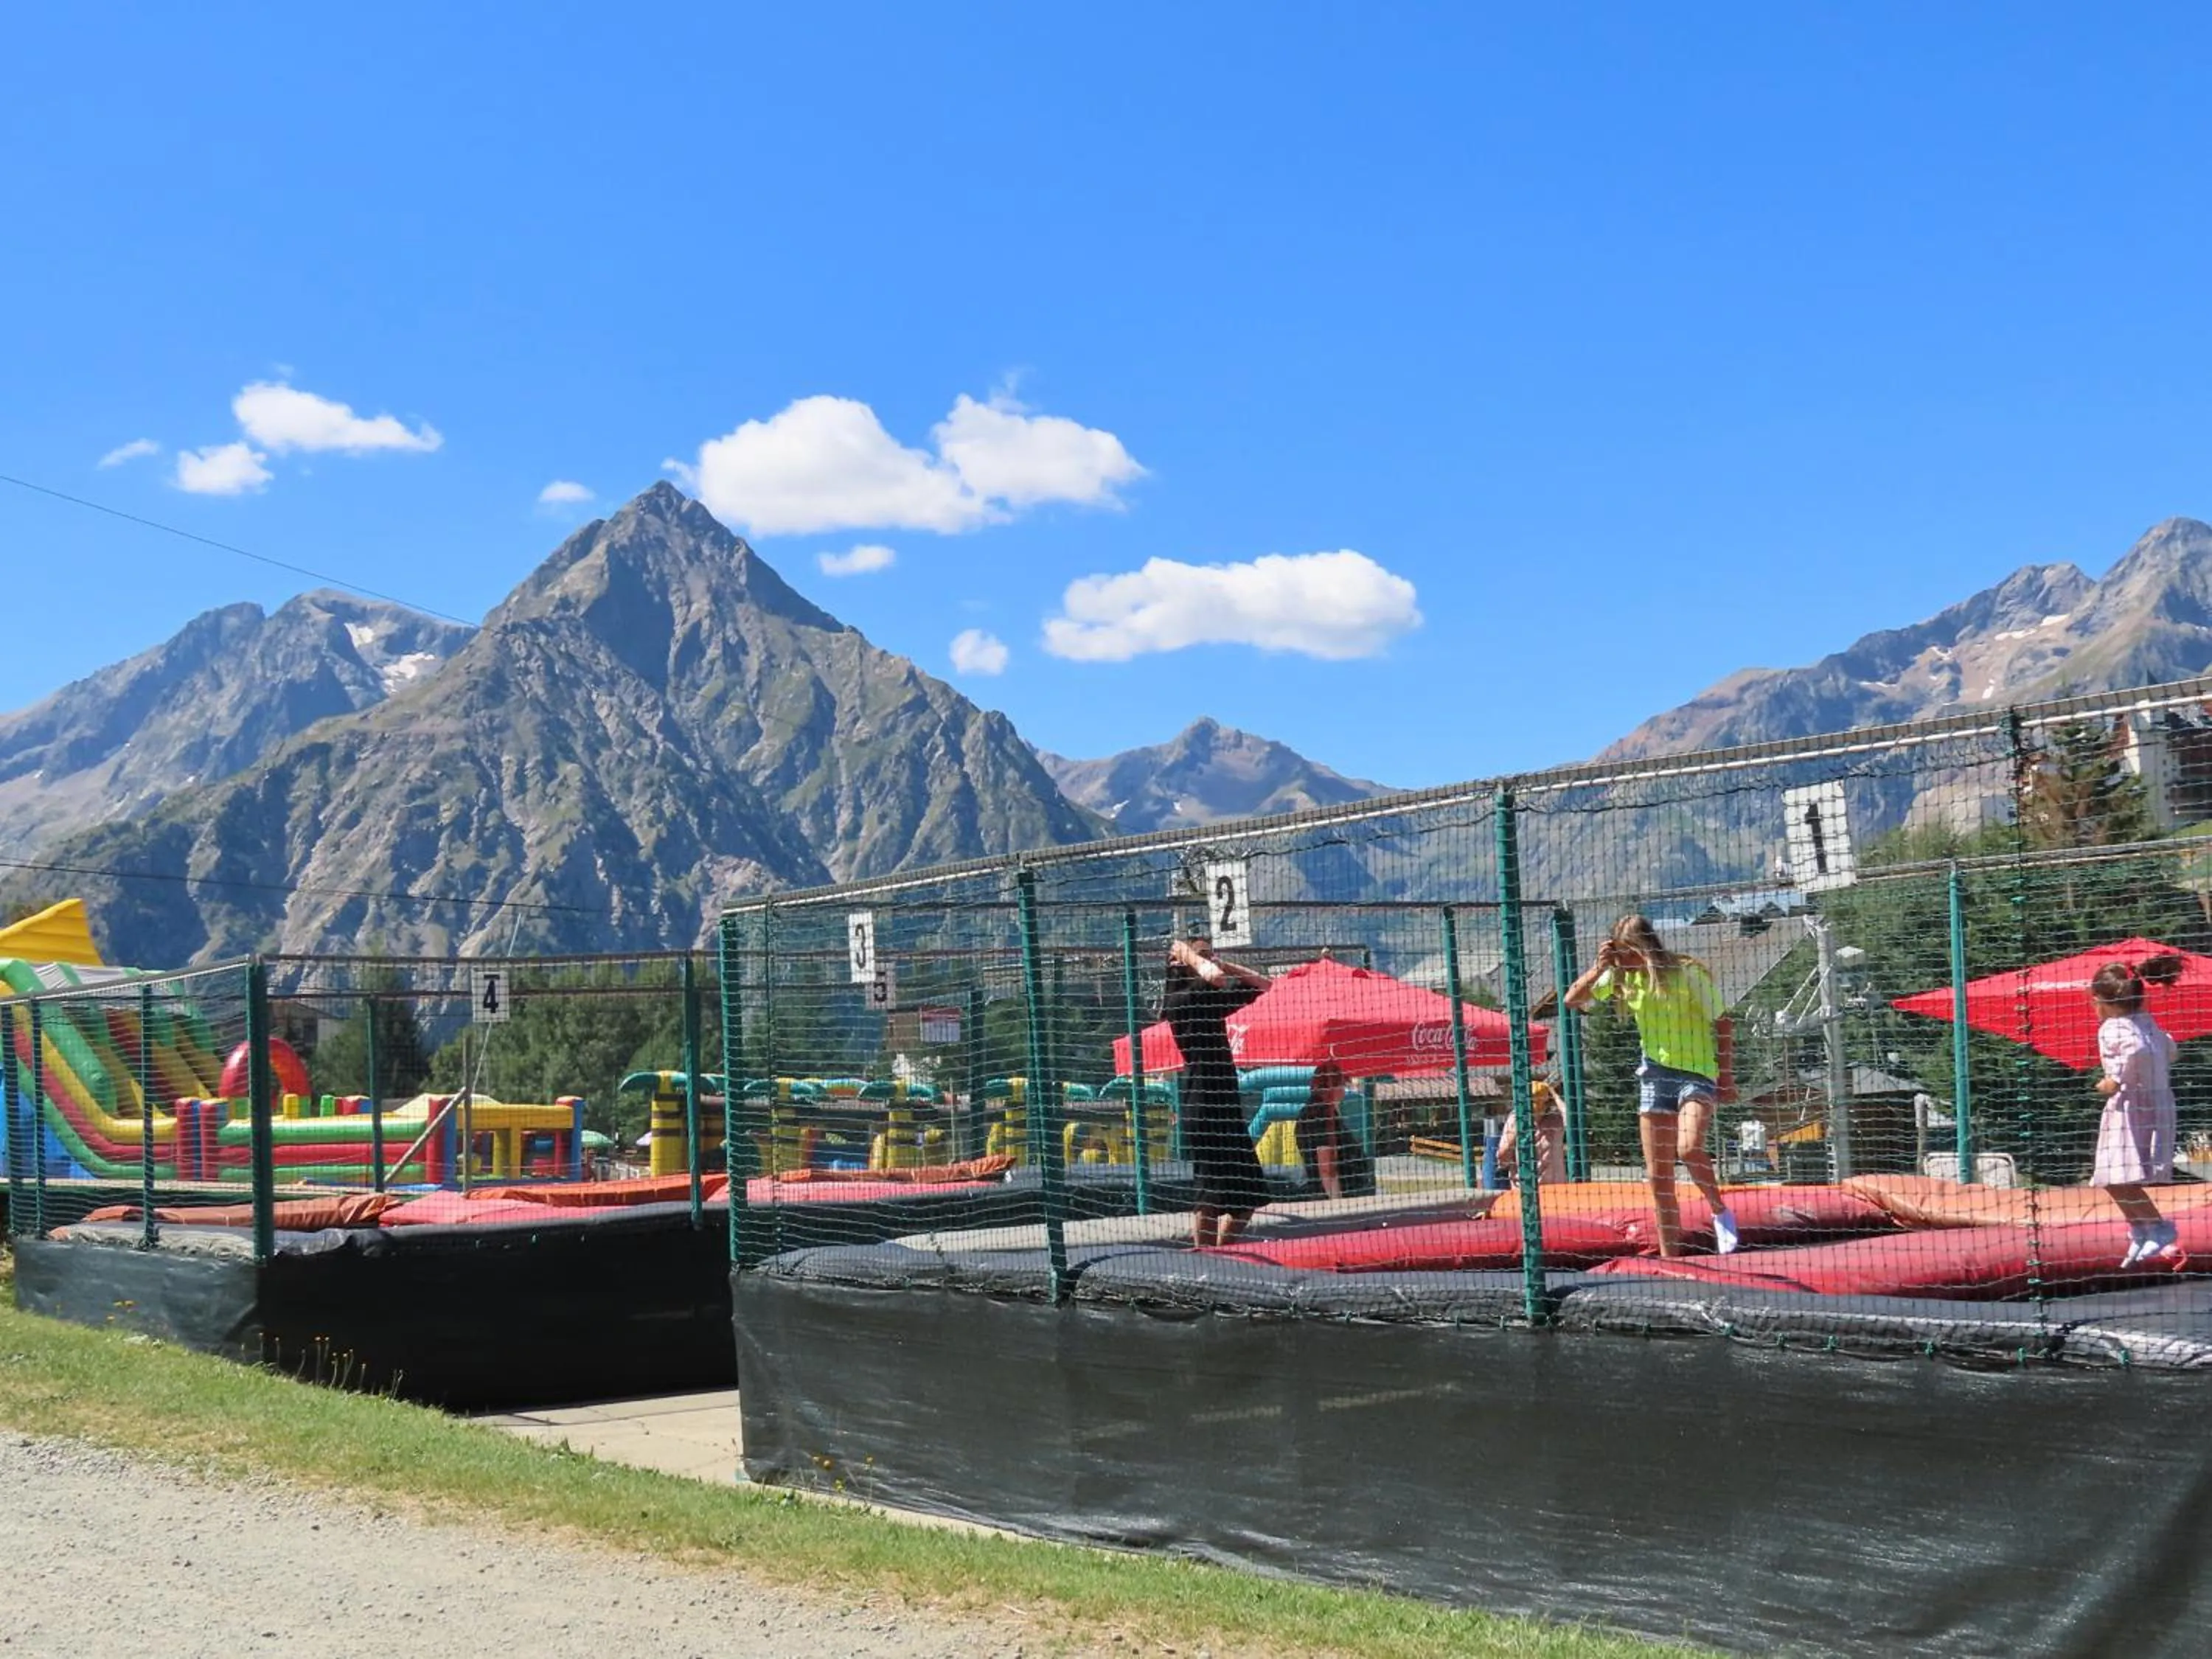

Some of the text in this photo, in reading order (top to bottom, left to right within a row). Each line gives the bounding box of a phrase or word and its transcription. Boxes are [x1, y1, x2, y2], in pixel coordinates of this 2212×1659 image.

[1805, 803, 1827, 873] 1
[1216, 876, 1237, 932] 2
[855, 924, 866, 969] 3
[483, 975, 500, 1013] 4
